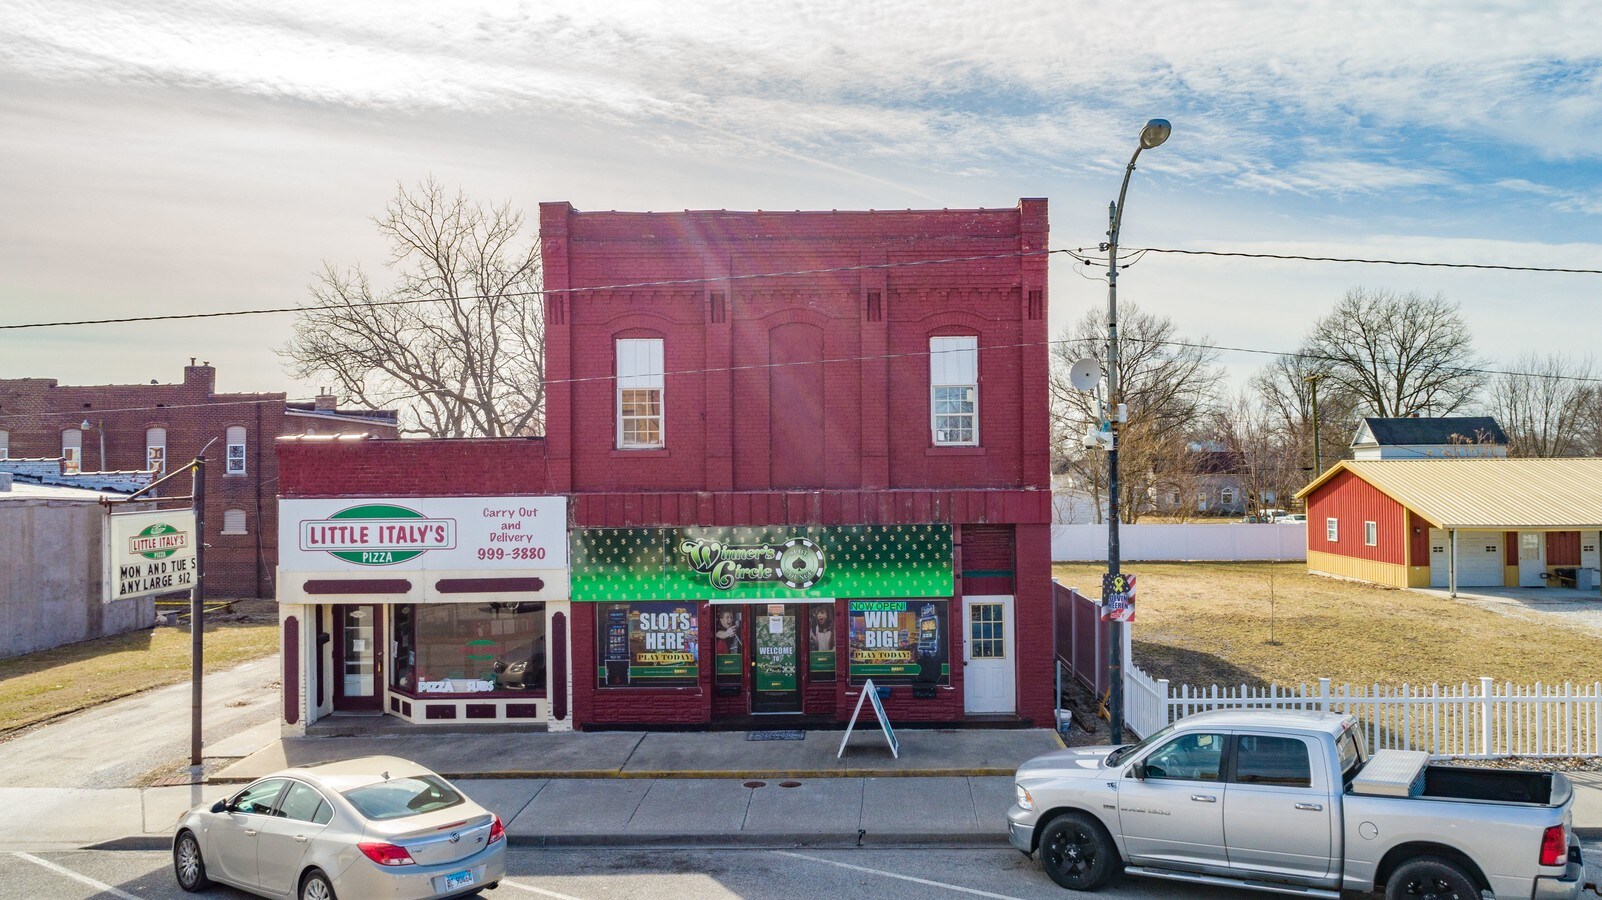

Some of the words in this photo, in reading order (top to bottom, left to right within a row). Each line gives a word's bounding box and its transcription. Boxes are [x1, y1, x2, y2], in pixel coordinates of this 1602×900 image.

[483, 507, 515, 519] Carry
[518, 506, 538, 517] Out
[501, 520, 521, 530] and
[133, 538, 156, 550] LITTLE
[159, 535, 184, 547] ITALY'S
[311, 526, 369, 544] LITTLE
[379, 524, 445, 544] ITALY'S
[490, 532, 533, 543] Delivery
[362, 551, 393, 563] PIZZA
[477, 547, 546, 560] 999-3880
[680, 540, 776, 570] Winner's
[121, 565, 141, 579] MON
[148, 562, 167, 576] AND
[171, 559, 186, 572] TUE
[711, 560, 772, 589] Circle
[120, 580, 141, 595] ANY
[143, 575, 172, 591] LARGE
[178, 572, 191, 583] $12
[640, 613, 690, 630] SLOTS
[864, 611, 898, 628] WIN
[645, 632, 685, 650] HERE
[865, 630, 899, 648] BIG!
[759, 647, 793, 655] WELCOME
[418, 681, 454, 693] PIZZA
